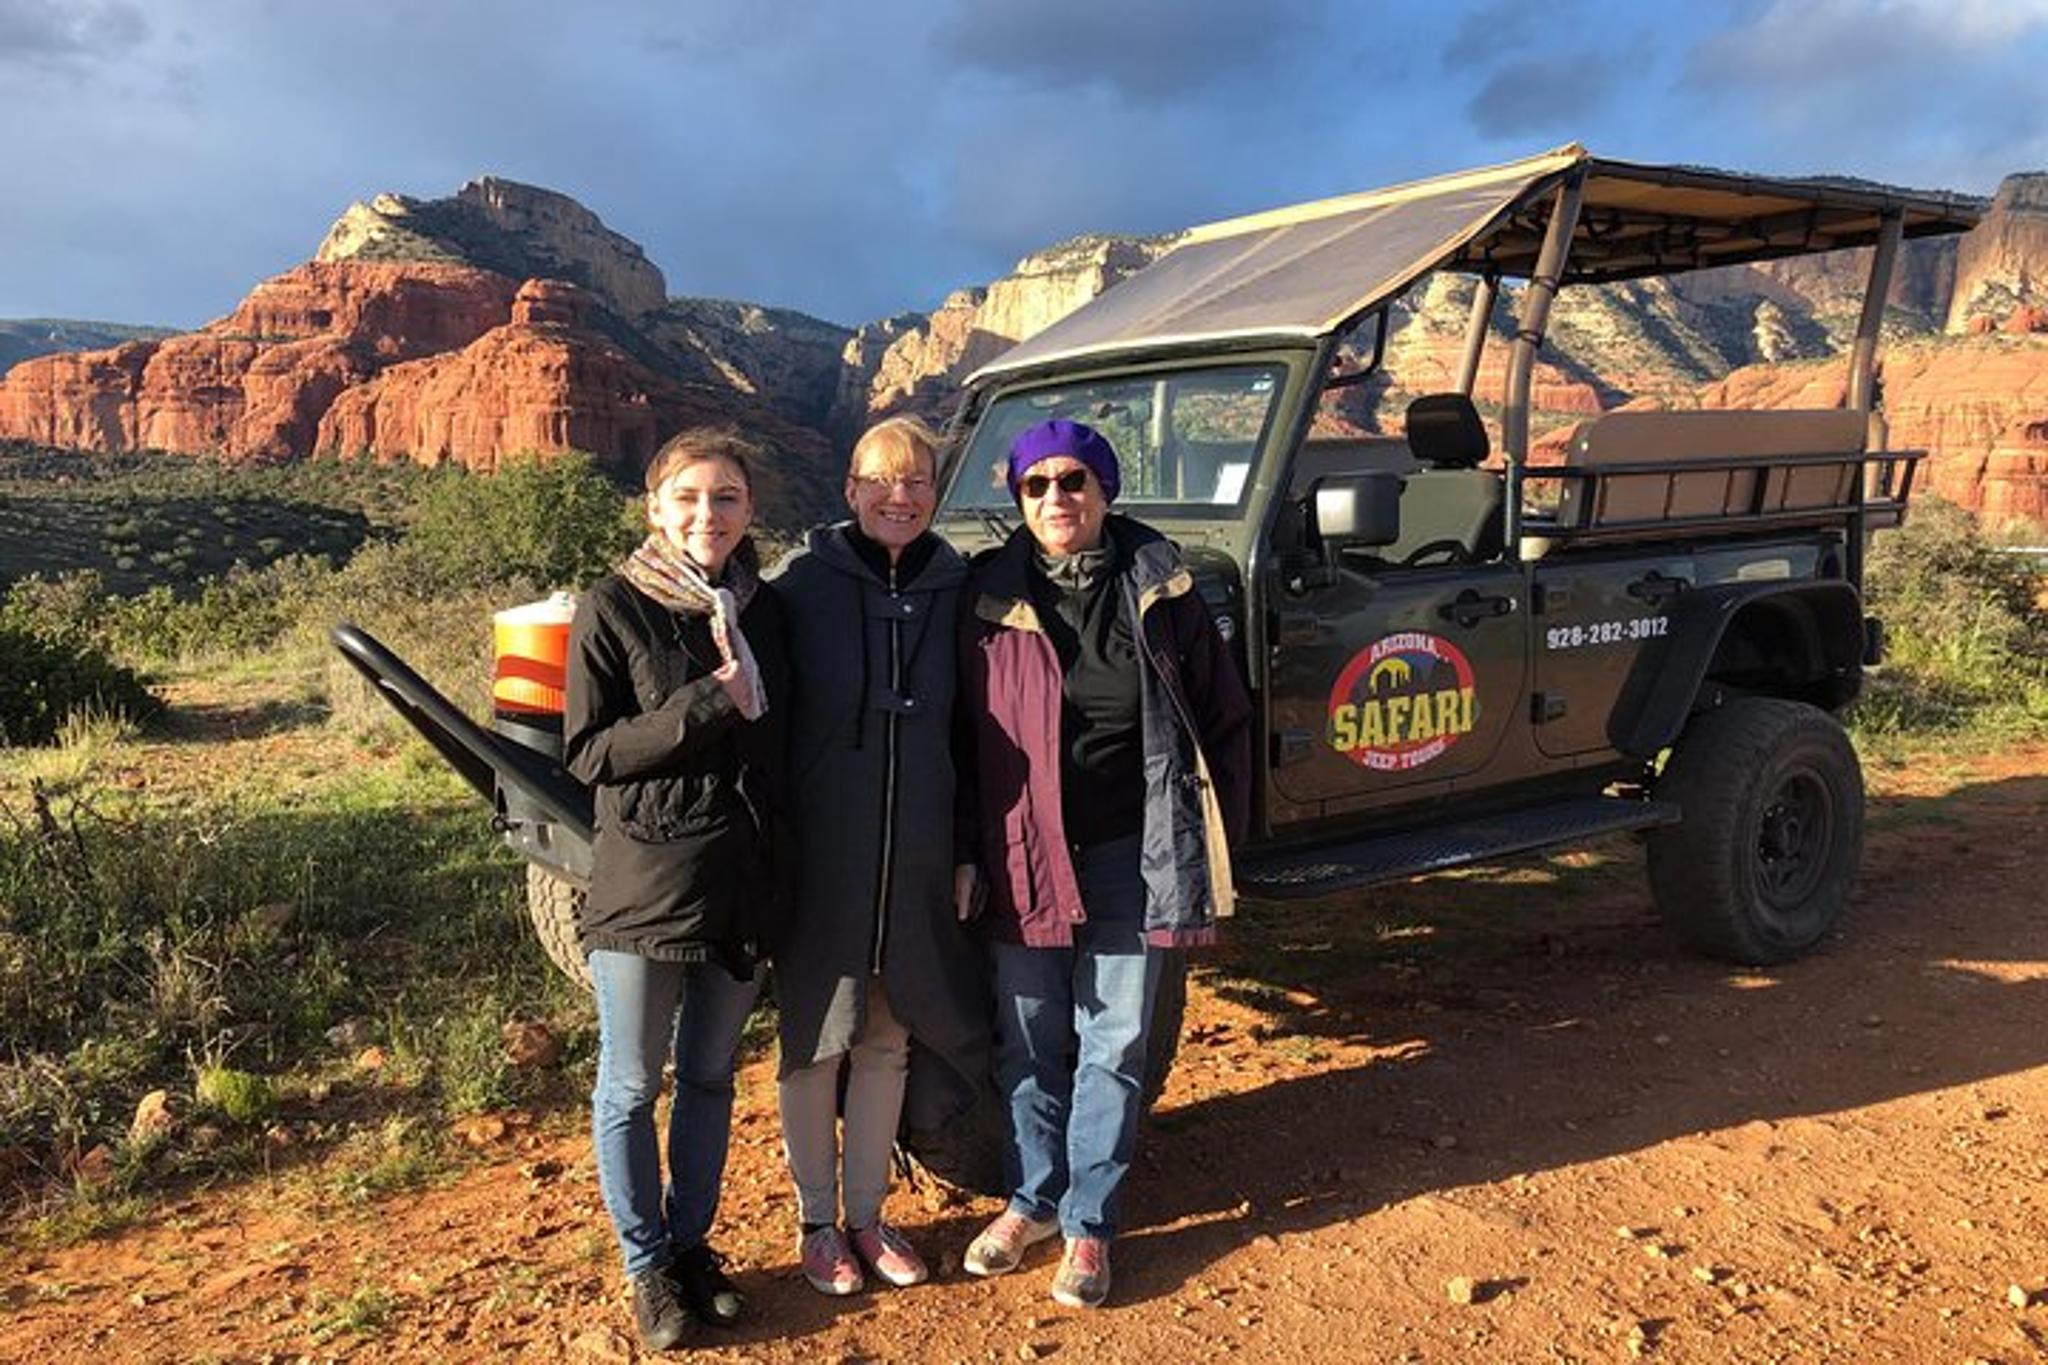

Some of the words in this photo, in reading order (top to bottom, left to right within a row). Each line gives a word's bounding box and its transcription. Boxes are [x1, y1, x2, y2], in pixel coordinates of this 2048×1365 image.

[1370, 633, 1438, 663] ARIZONA
[1547, 616, 1668, 649] 928-282-3012
[1333, 688, 1474, 752] SAFARI
